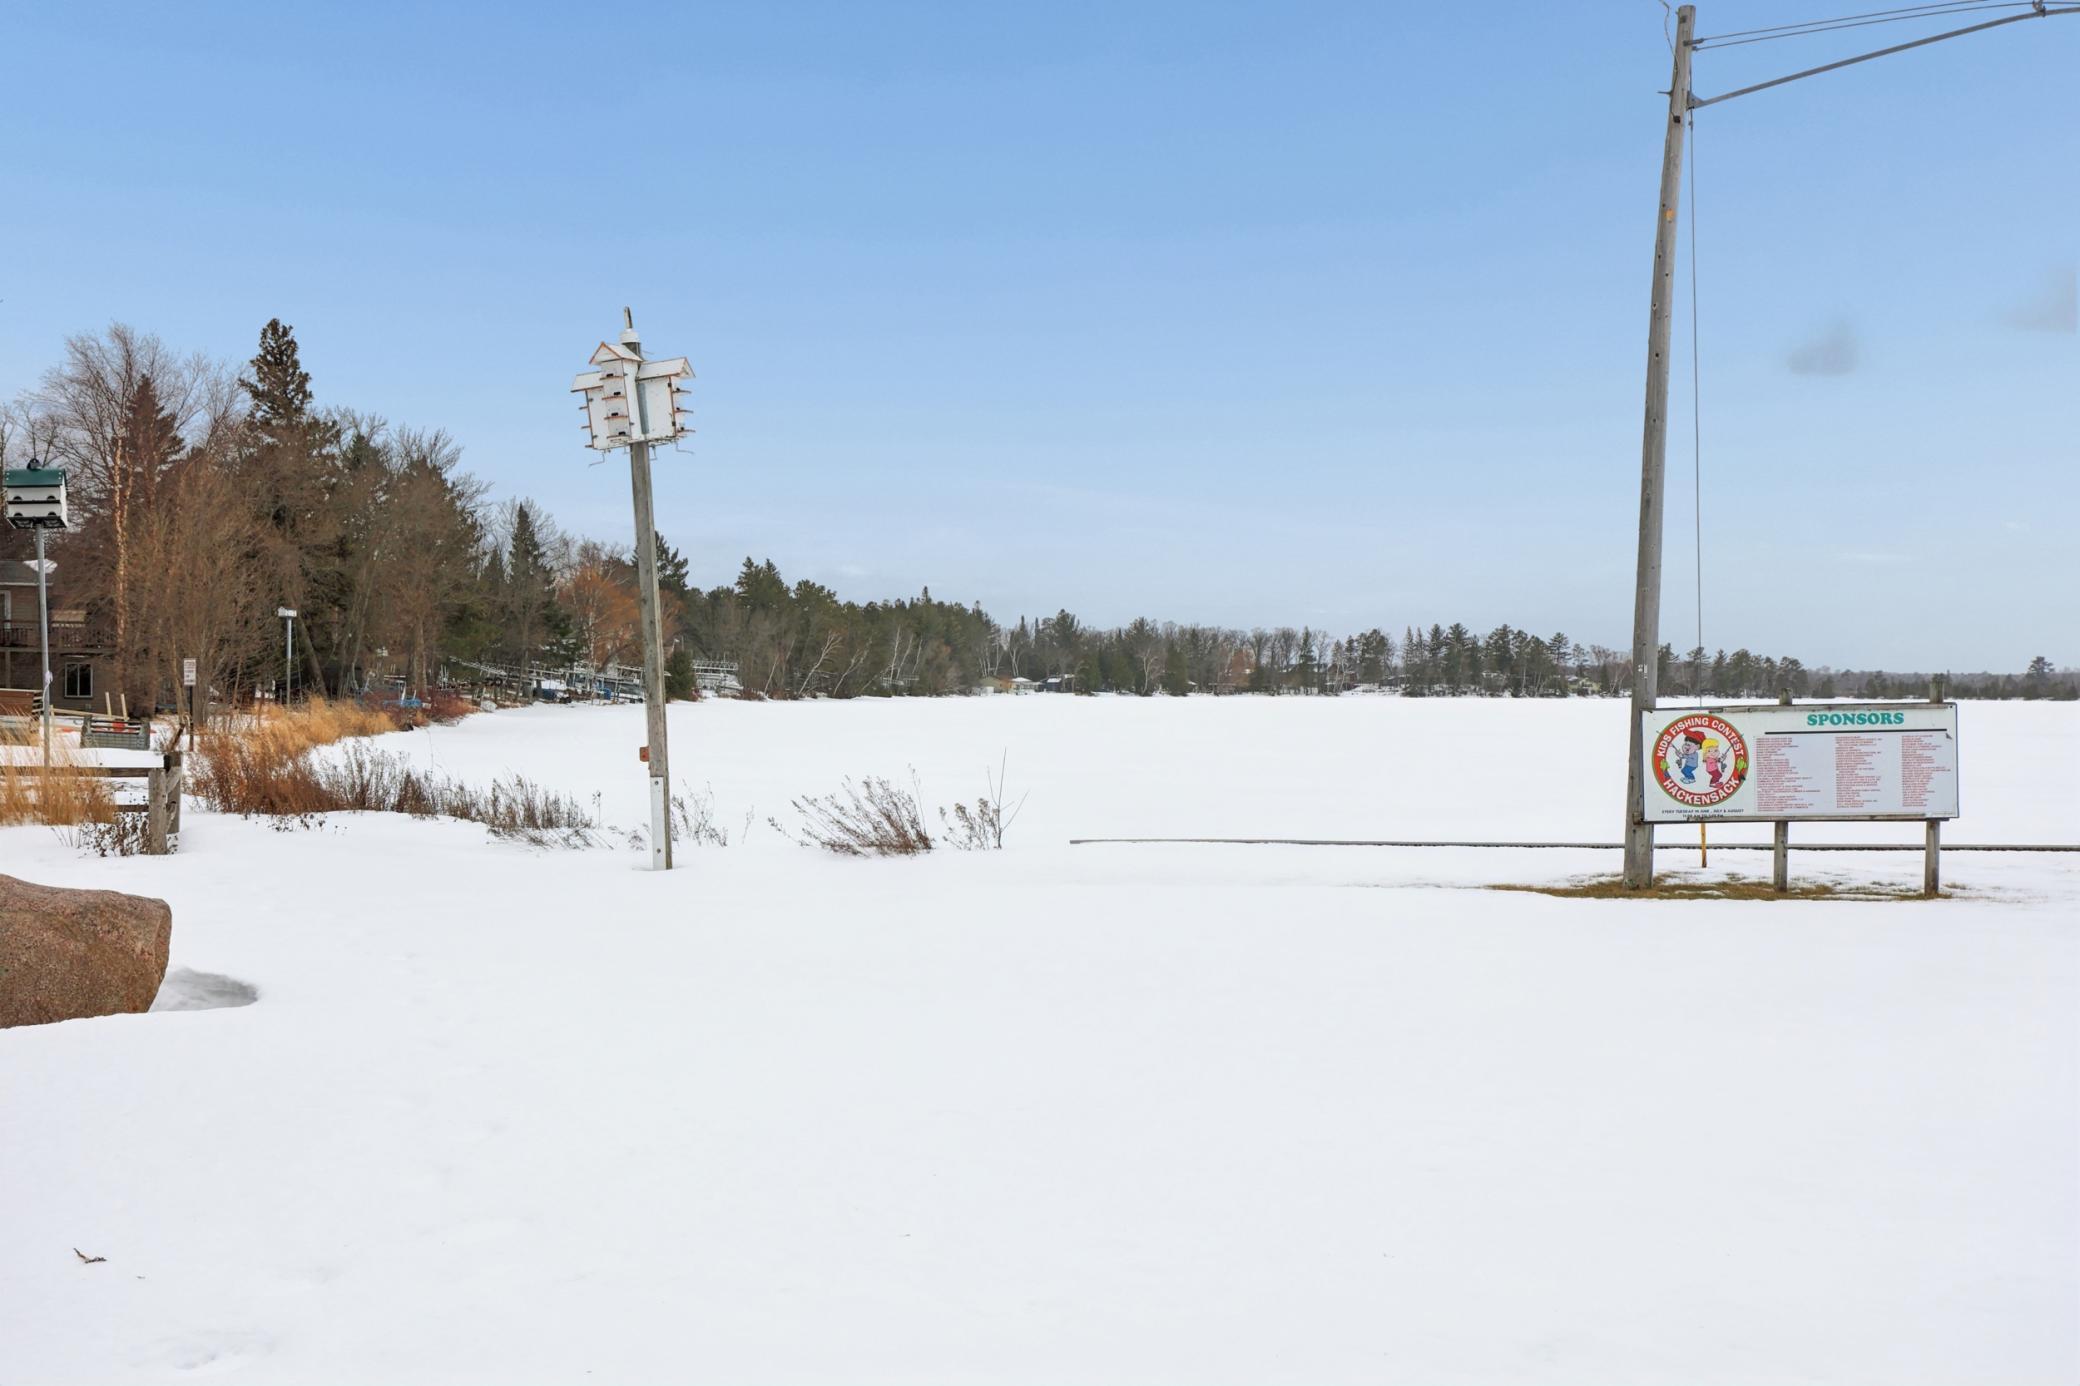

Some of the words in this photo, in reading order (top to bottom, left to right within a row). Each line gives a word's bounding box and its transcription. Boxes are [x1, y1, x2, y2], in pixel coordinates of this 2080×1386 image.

[1807, 712, 1904, 726] SPONSORS
[1657, 734, 1671, 757] KIDS
[1669, 717, 1708, 735] FISHING
[1711, 719, 1744, 756] CONTEST
[1663, 777, 1739, 805] HACKENSACK
